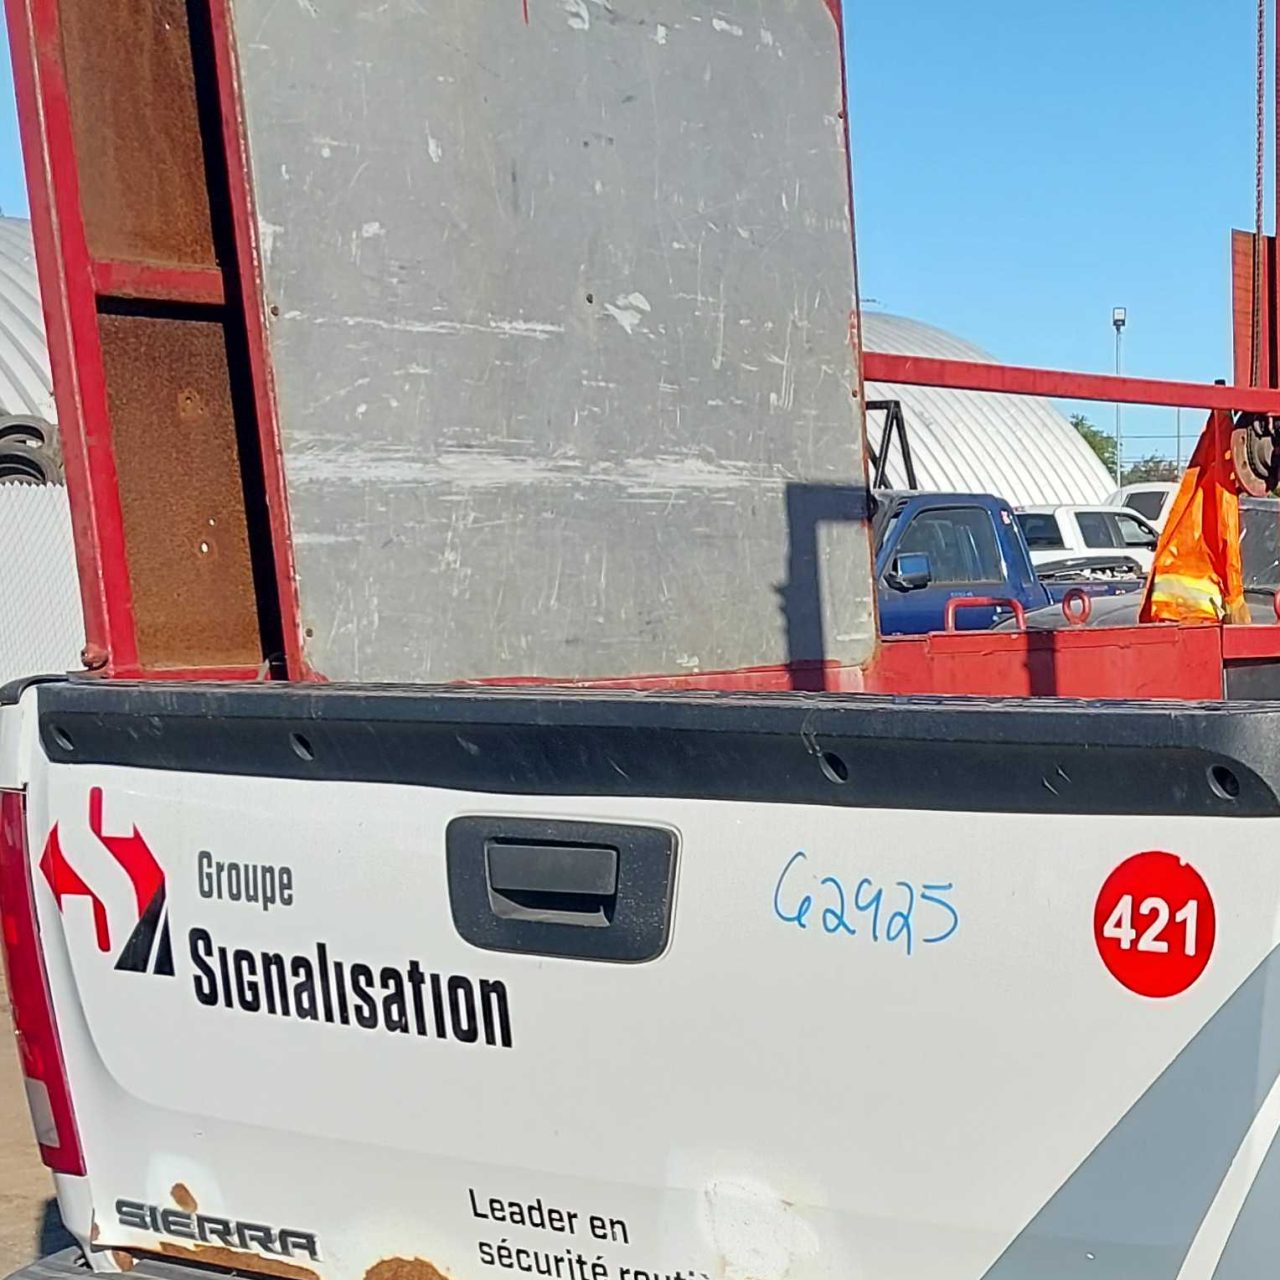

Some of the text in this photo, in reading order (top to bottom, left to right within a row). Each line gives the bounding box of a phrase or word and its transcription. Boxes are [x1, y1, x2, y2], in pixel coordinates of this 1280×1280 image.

[197, 849, 295, 911] Groupe
[773, 851, 959, 955] 62925
[1102, 894, 1199, 957] 421
[187, 927, 514, 1049] Signalisation
[115, 1198, 319, 1262] SIERRA
[468, 1187, 631, 1245] Leader en
